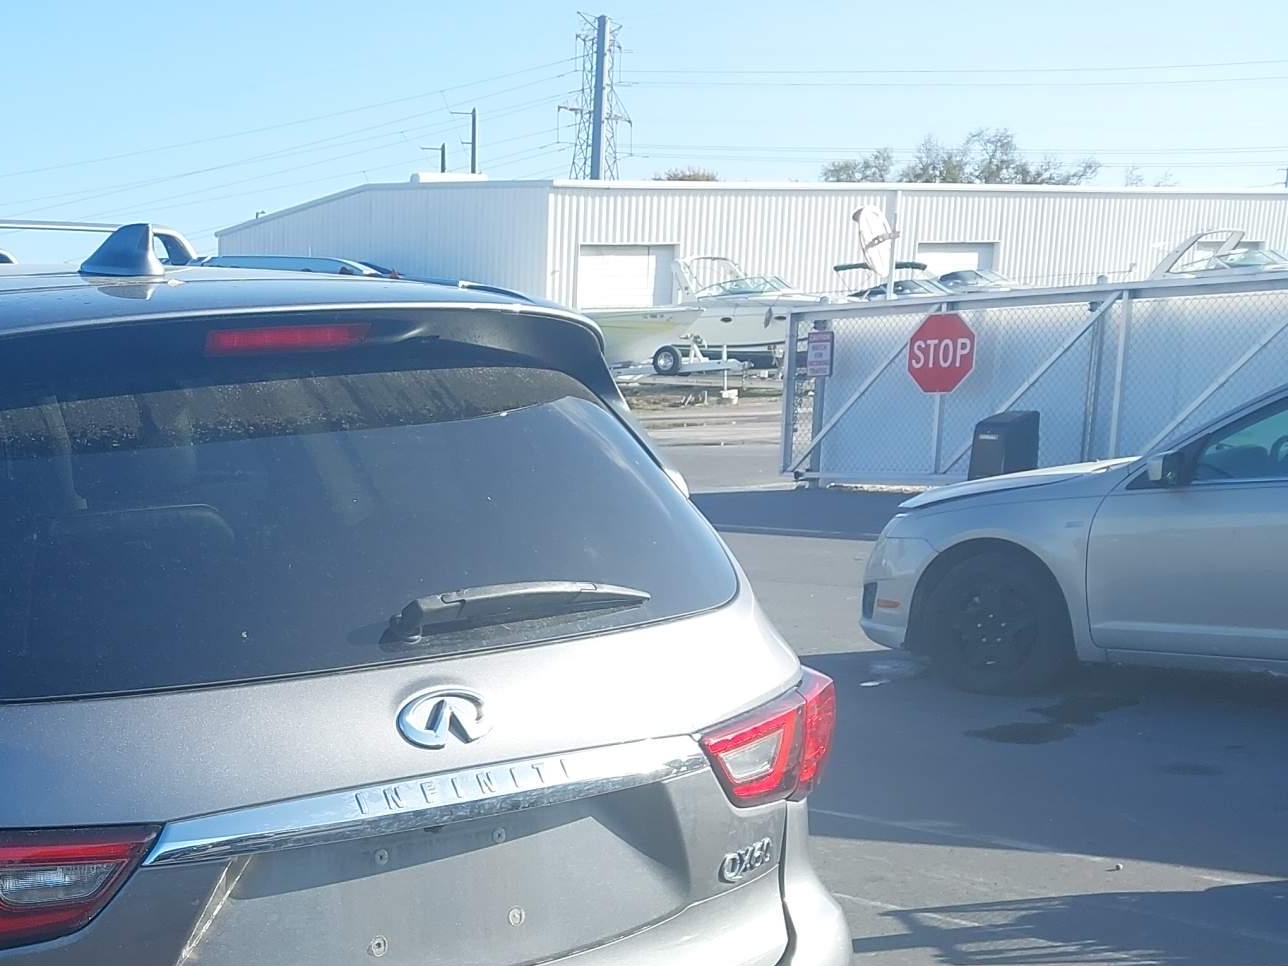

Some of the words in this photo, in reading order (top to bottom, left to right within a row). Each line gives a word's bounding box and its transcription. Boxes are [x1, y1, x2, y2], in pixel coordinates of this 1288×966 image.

[911, 337, 972, 369] STOP
[354, 758, 570, 814] INFINITI
[718, 837, 772, 884] QX60
